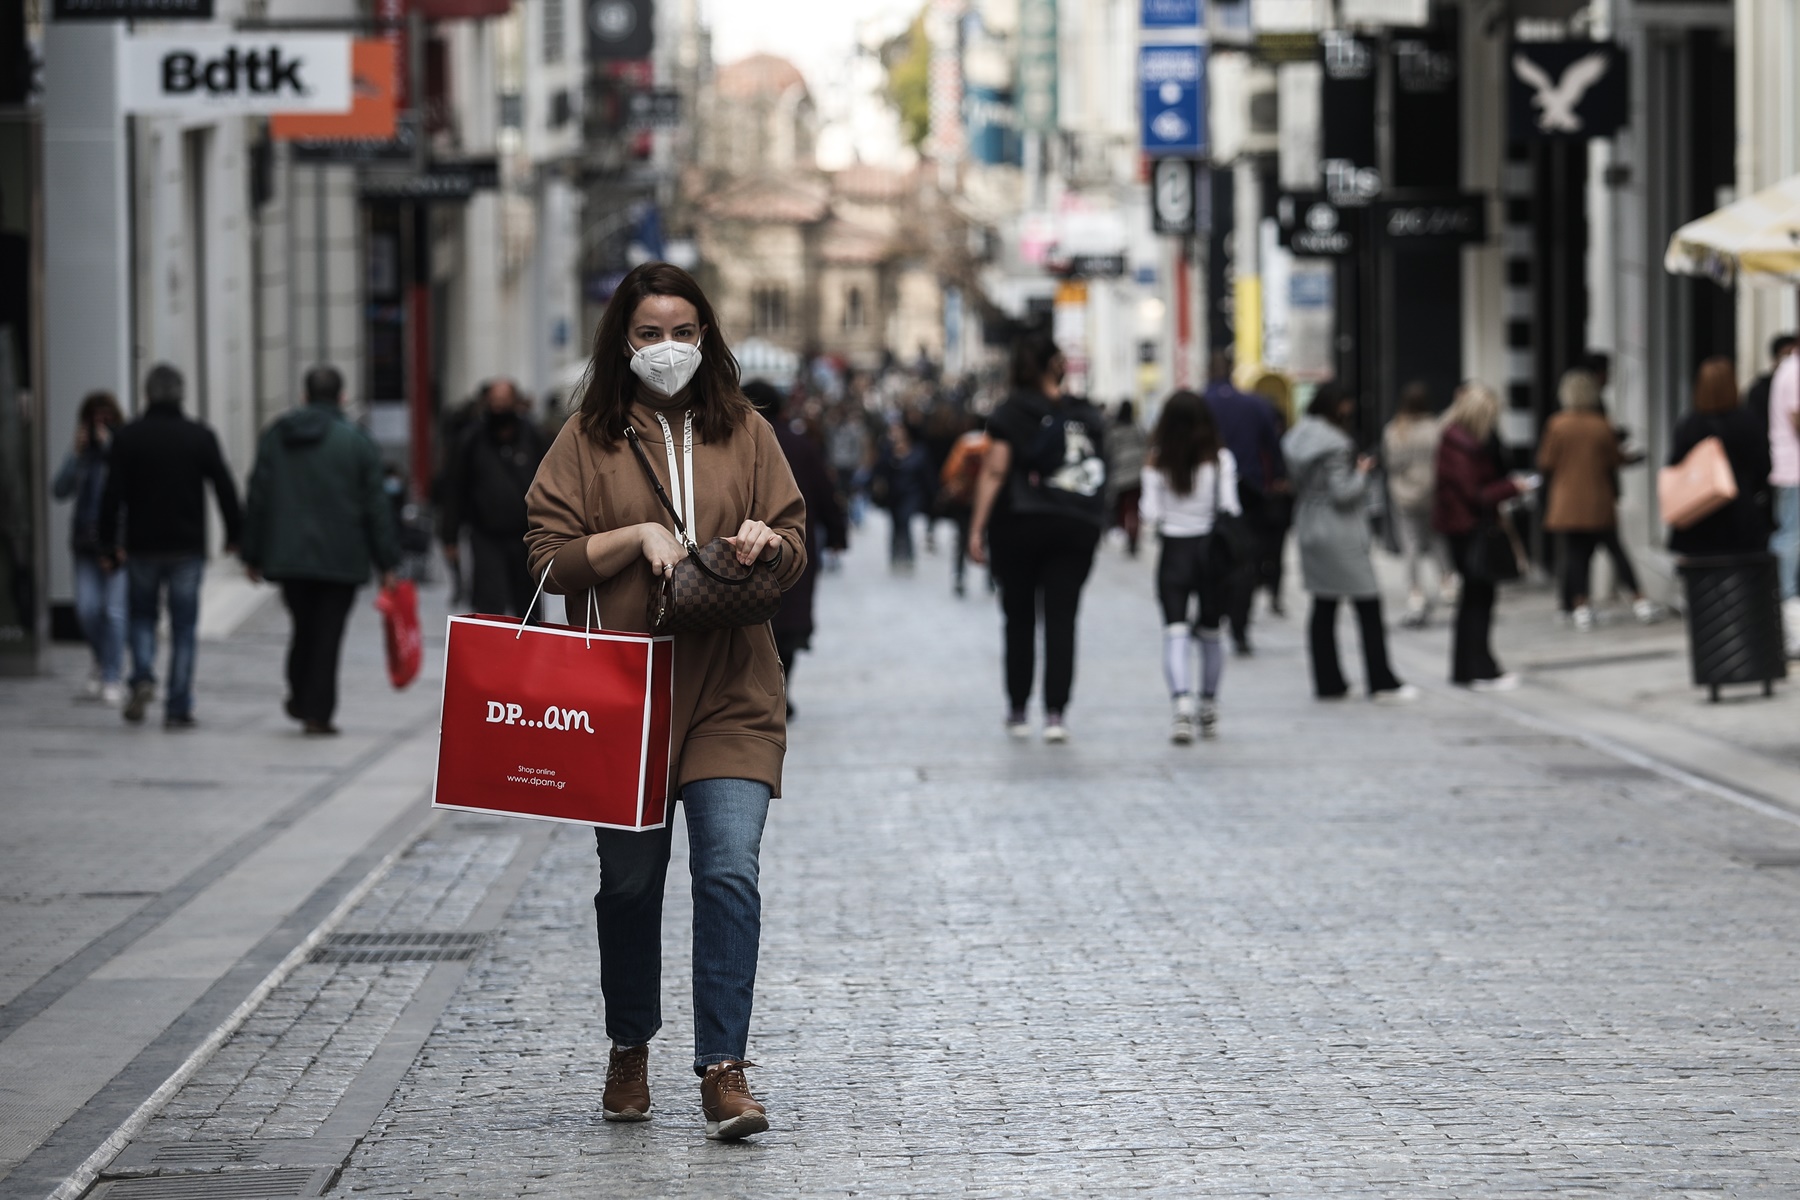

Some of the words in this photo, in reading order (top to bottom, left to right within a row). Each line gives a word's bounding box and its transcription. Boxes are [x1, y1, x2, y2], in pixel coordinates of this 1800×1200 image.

[518, 766, 534, 775] Shop
[536, 768, 555, 776] online
[507, 775, 566, 789] www.dpam.gr
